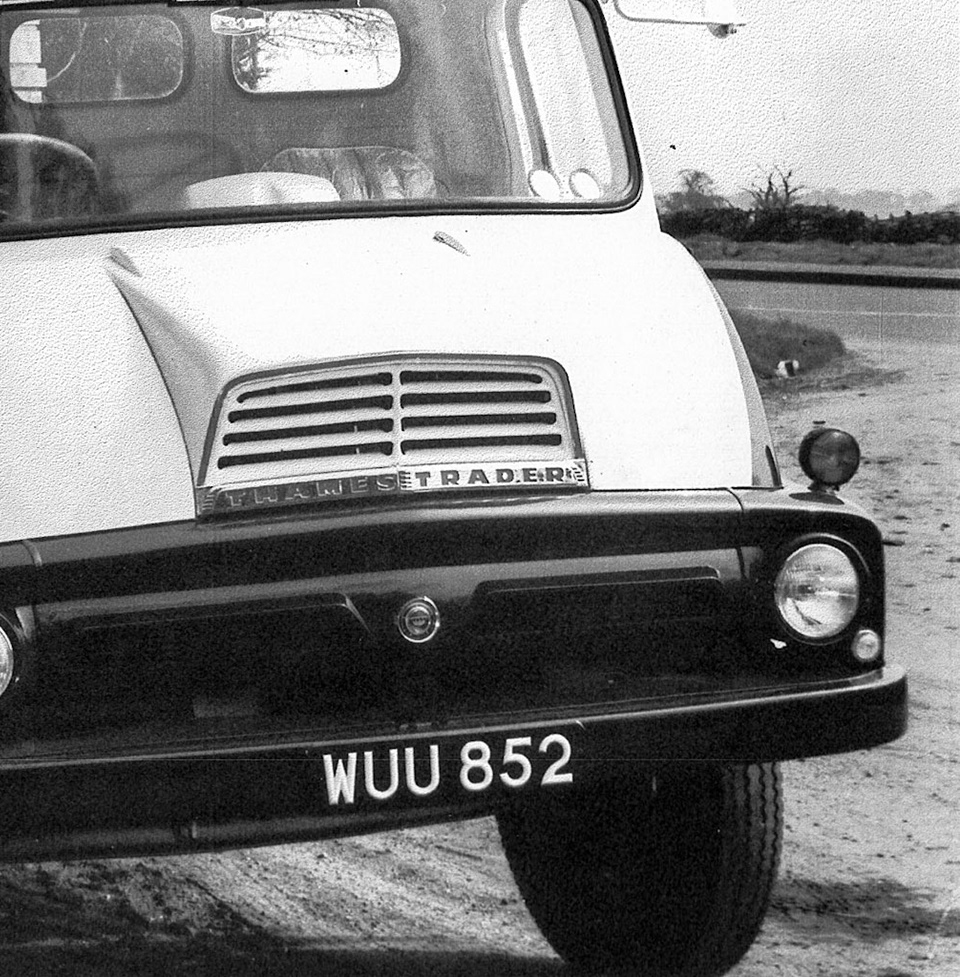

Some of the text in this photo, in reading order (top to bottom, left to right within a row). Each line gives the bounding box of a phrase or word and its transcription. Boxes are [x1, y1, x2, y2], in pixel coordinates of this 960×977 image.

[225, 466, 565, 507] THAMES TRADER
[322, 733, 574, 805] WUU 852
